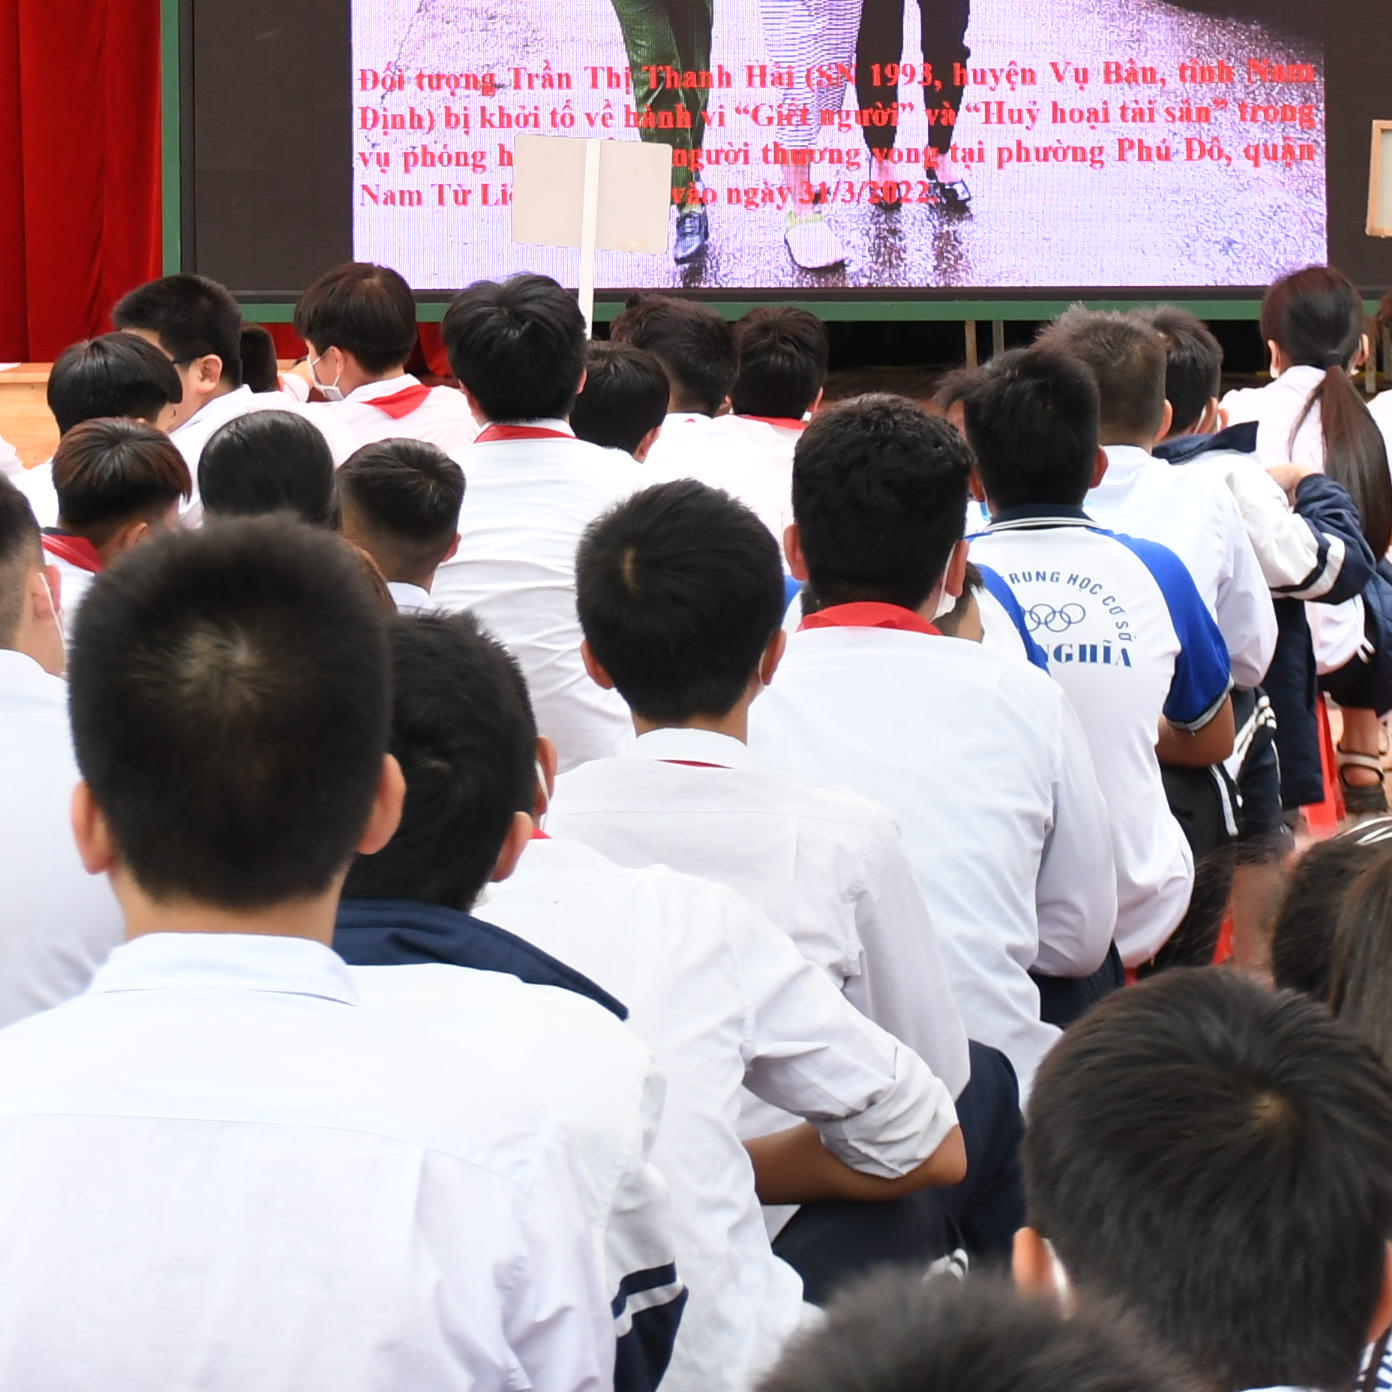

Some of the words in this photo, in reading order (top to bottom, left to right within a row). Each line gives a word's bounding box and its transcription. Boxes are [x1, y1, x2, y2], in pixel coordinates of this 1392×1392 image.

[415, 67, 496, 97] tượng
[584, 65, 632, 95] Thị
[642, 64, 732, 89] Thanh
[870, 62, 943, 92] 1993,
[952, 60, 1037, 91] huyện
[1049, 61, 1089, 91] Vụ
[1247, 57, 1316, 84] Nam
[358, 106, 436, 136] Định)
[444, 105, 470, 136] bị
[702, 105, 726, 128] vi
[924, 101, 958, 127] và
[1051, 100, 1111, 131] hoại
[1119, 99, 1156, 124] tài
[1238, 100, 1317, 130] trong
[358, 151, 390, 174] vụ
[403, 143, 487, 174] phóng
[672, 142, 751, 172] người
[761, 141, 862, 171] thương
[872, 145, 940, 171] vong
[949, 139, 985, 168] tại
[996, 136, 1105, 169] phường
[1244, 136, 1316, 168] quận
[360, 184, 423, 207] Nam
[431, 182, 473, 207] Từ
[672, 182, 717, 205] vào
[727, 181, 792, 210] ngày
[1008, 570, 1061, 585] RUNG
[1066, 573, 1103, 595] HỌC
[1102, 595, 1126, 615] CƠ
[1046, 639, 1133, 668] GHĨA
